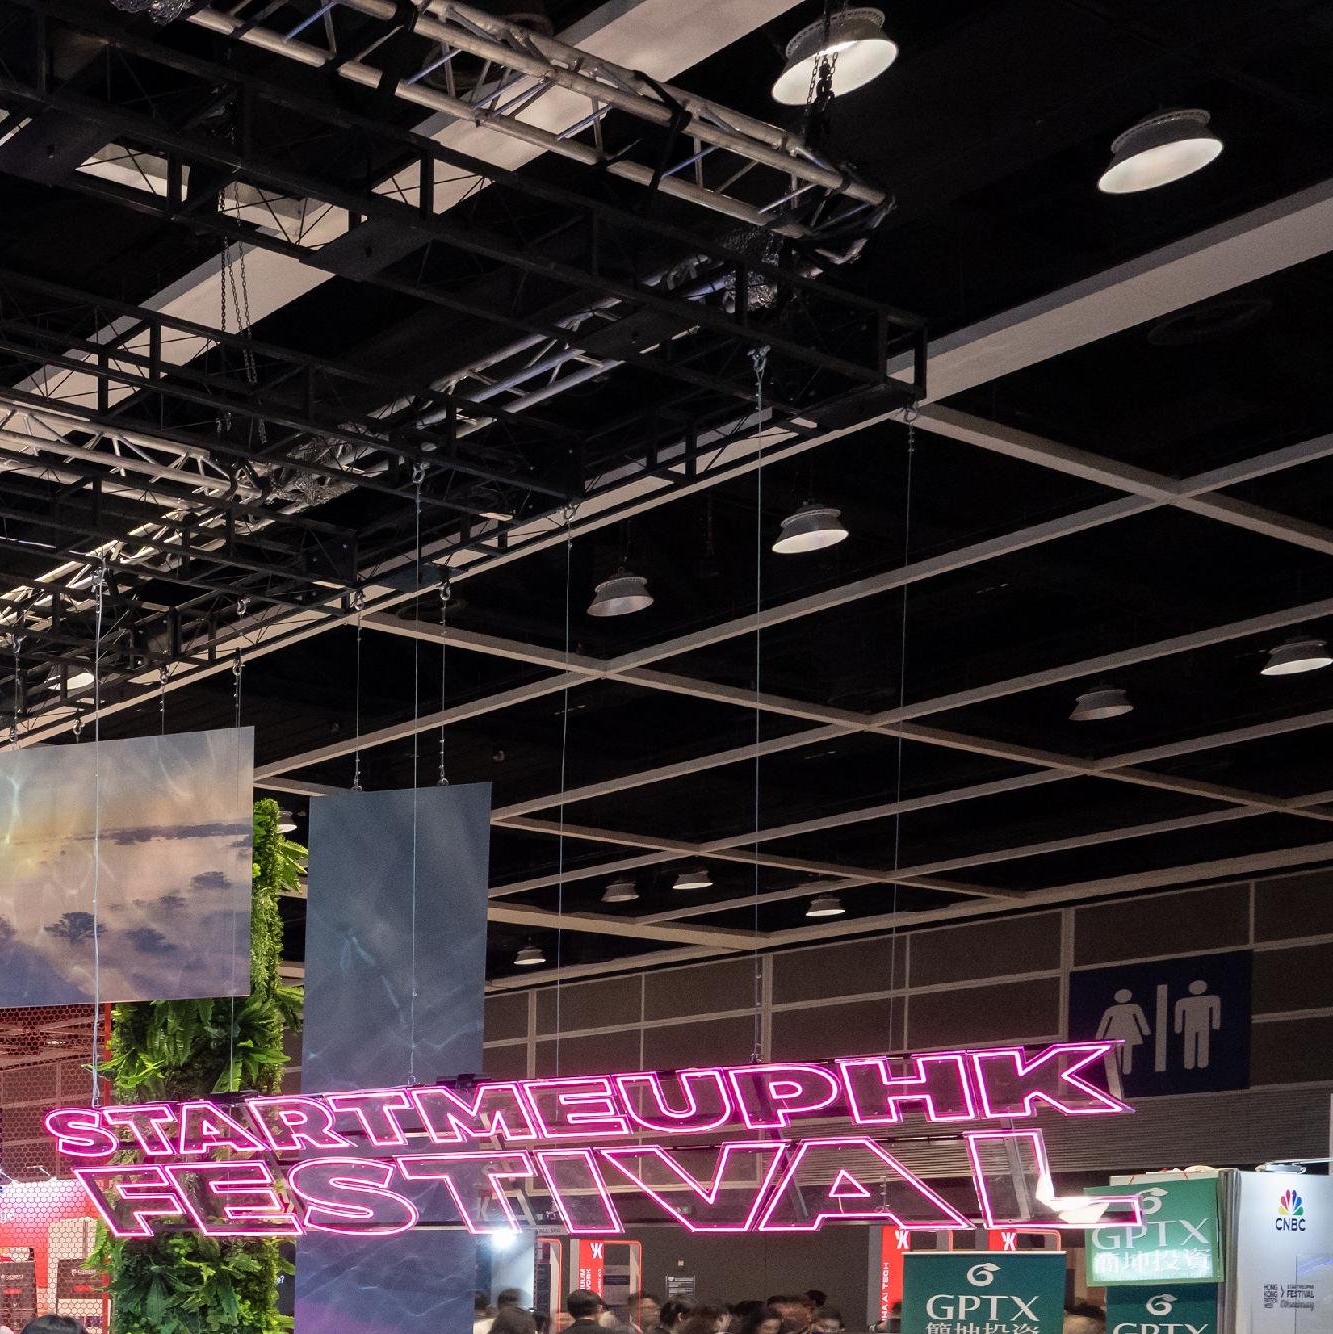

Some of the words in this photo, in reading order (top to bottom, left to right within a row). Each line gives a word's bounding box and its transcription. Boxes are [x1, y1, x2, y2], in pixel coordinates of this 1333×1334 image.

[44, 1040, 1134, 1157] STARTMEUPHK
[71, 1129, 1142, 1235] FESTIVAL
[1091, 1218, 1211, 1250] GPTX
[1275, 1217, 1307, 1232] CNBC
[926, 1293, 1040, 1322] GPTX
[1286, 1289, 1315, 1299] FESTIVAL
